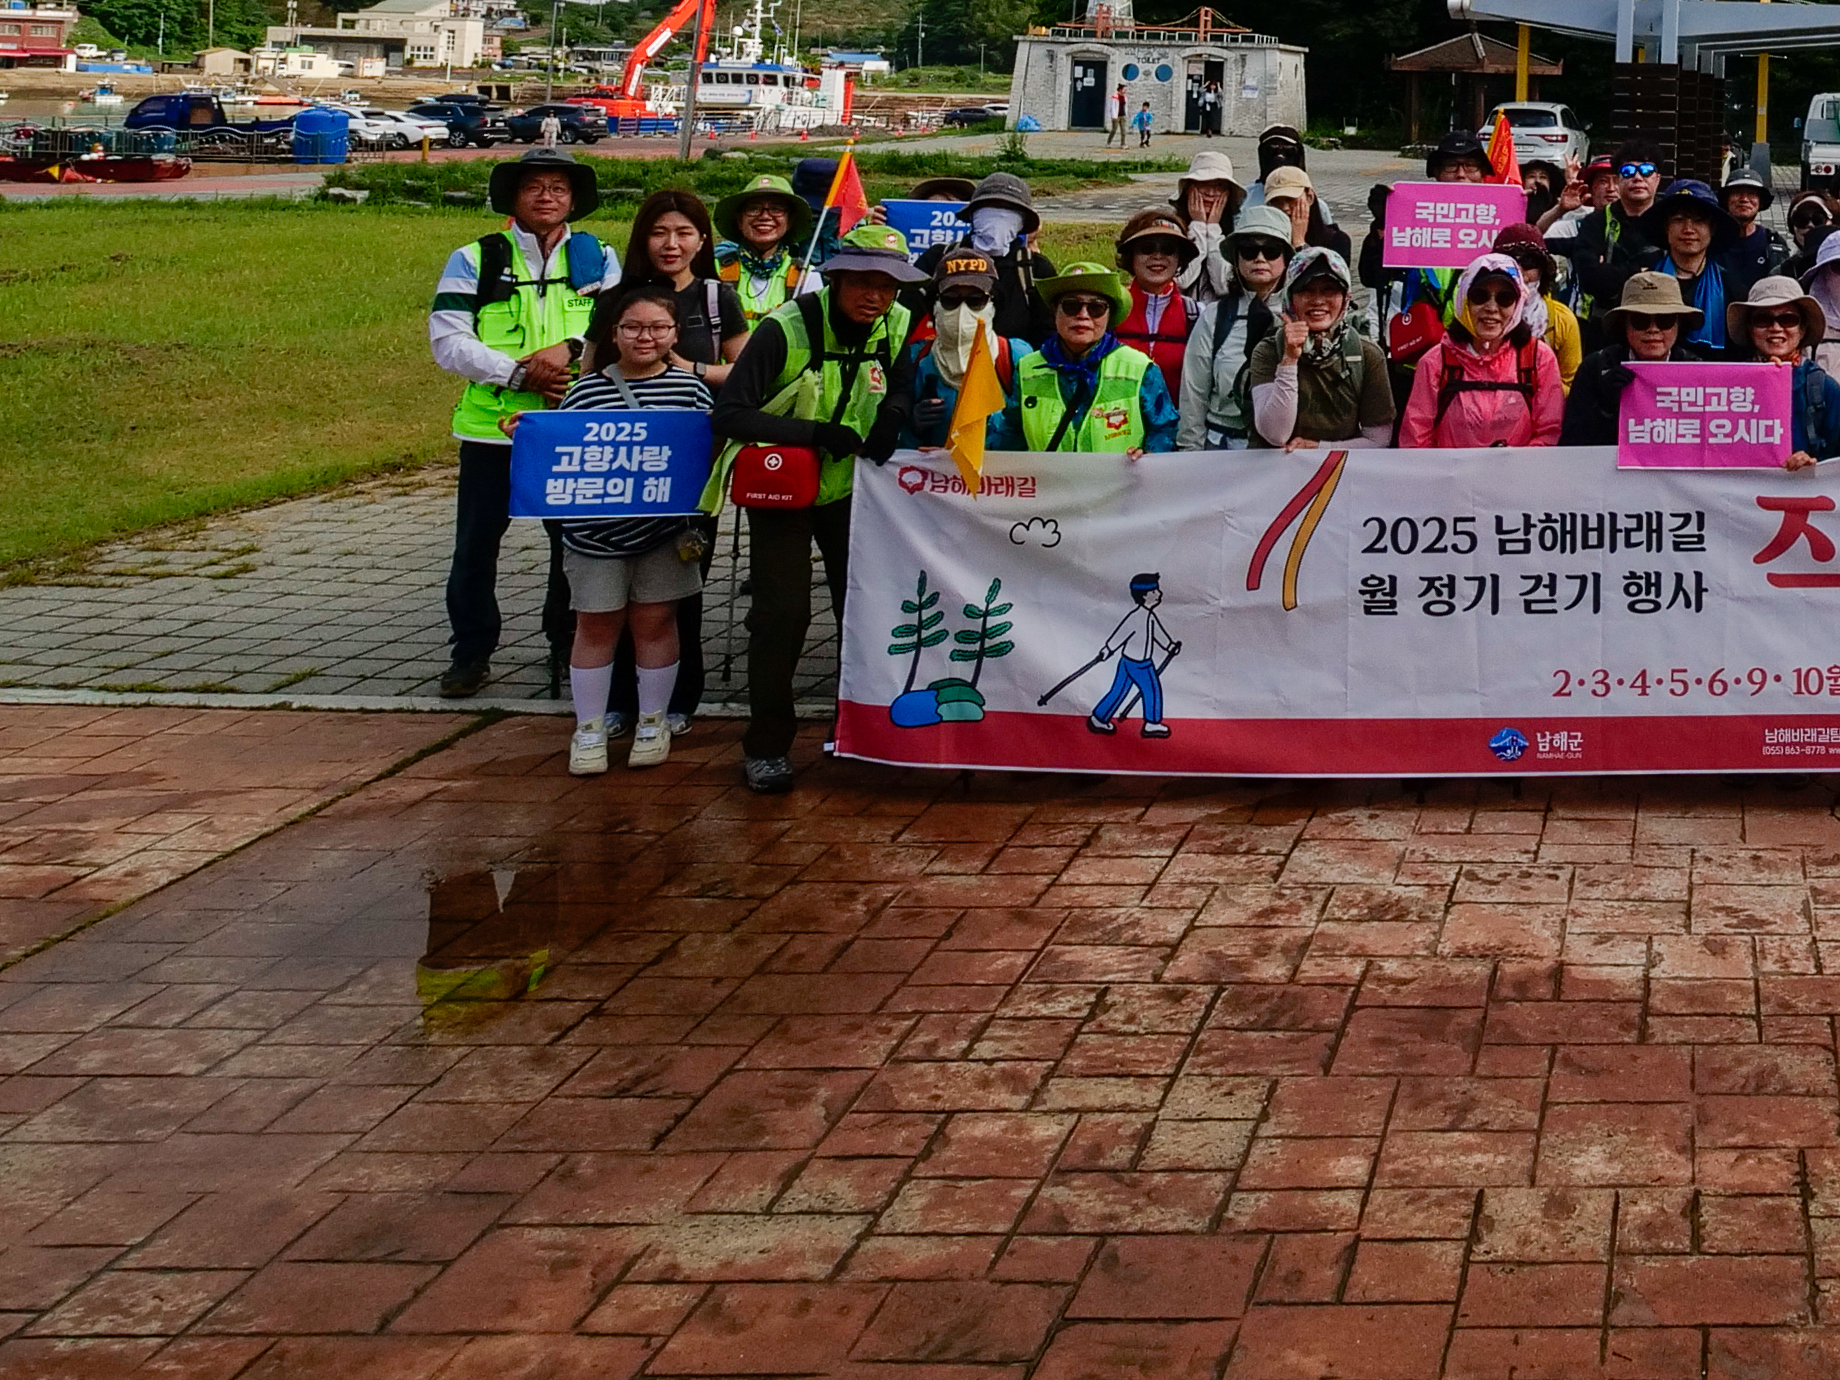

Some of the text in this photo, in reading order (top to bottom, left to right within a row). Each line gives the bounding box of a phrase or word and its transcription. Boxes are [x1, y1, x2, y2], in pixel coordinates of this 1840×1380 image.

[931, 211, 971, 227] 20
[1415, 202, 1500, 225] 국민고향,
[909, 228, 971, 248] 고향
[1392, 227, 1502, 248] 남해로 오시
[946, 259, 987, 274] NYPD
[568, 299, 592, 307] STAFF
[1656, 386, 1760, 413] 국민고향,
[583, 423, 647, 441] 2025
[1628, 418, 1783, 444] 남해로 오시다
[552, 446, 672, 472] 고향사랑
[546, 477, 671, 505] 방문의 해
[1361, 511, 1706, 556] 2025 남해바래길
[1358, 571, 1709, 616] 월 정기 걷기 행사
[1536, 731, 1583, 751] 남해군
